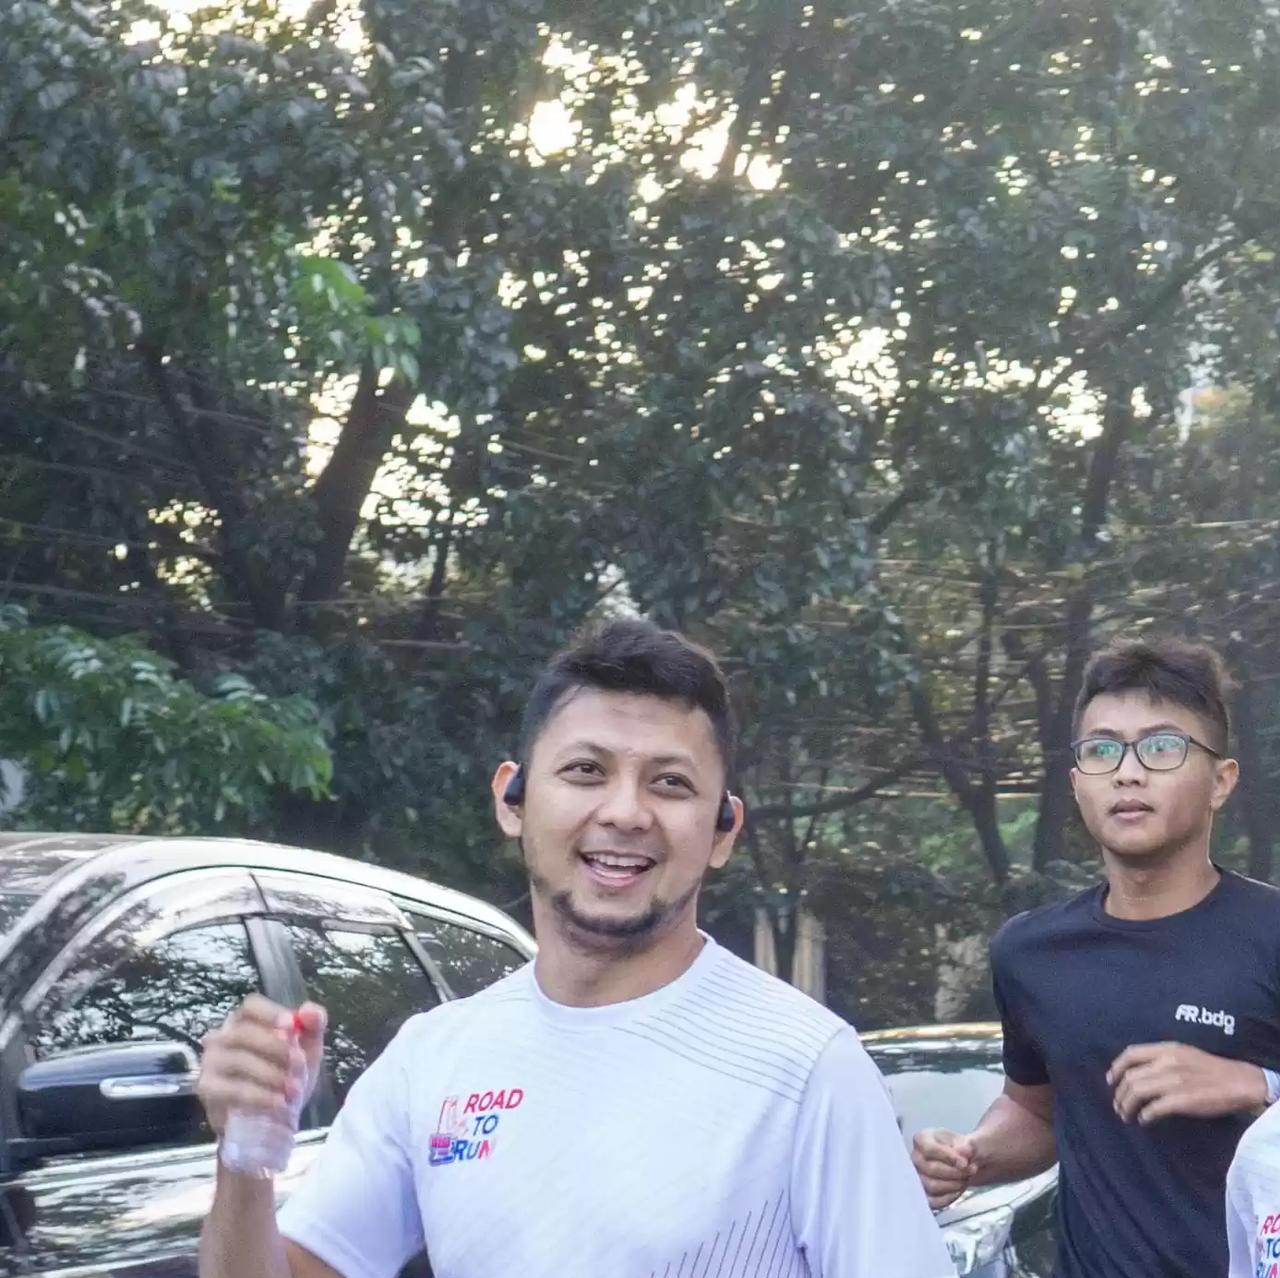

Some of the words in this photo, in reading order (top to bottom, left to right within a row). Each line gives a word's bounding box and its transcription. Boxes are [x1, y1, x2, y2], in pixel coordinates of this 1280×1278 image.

[464, 1088, 524, 1113] ROAD
[473, 1114, 499, 1136] TO
[453, 1139, 493, 1161] RUN
